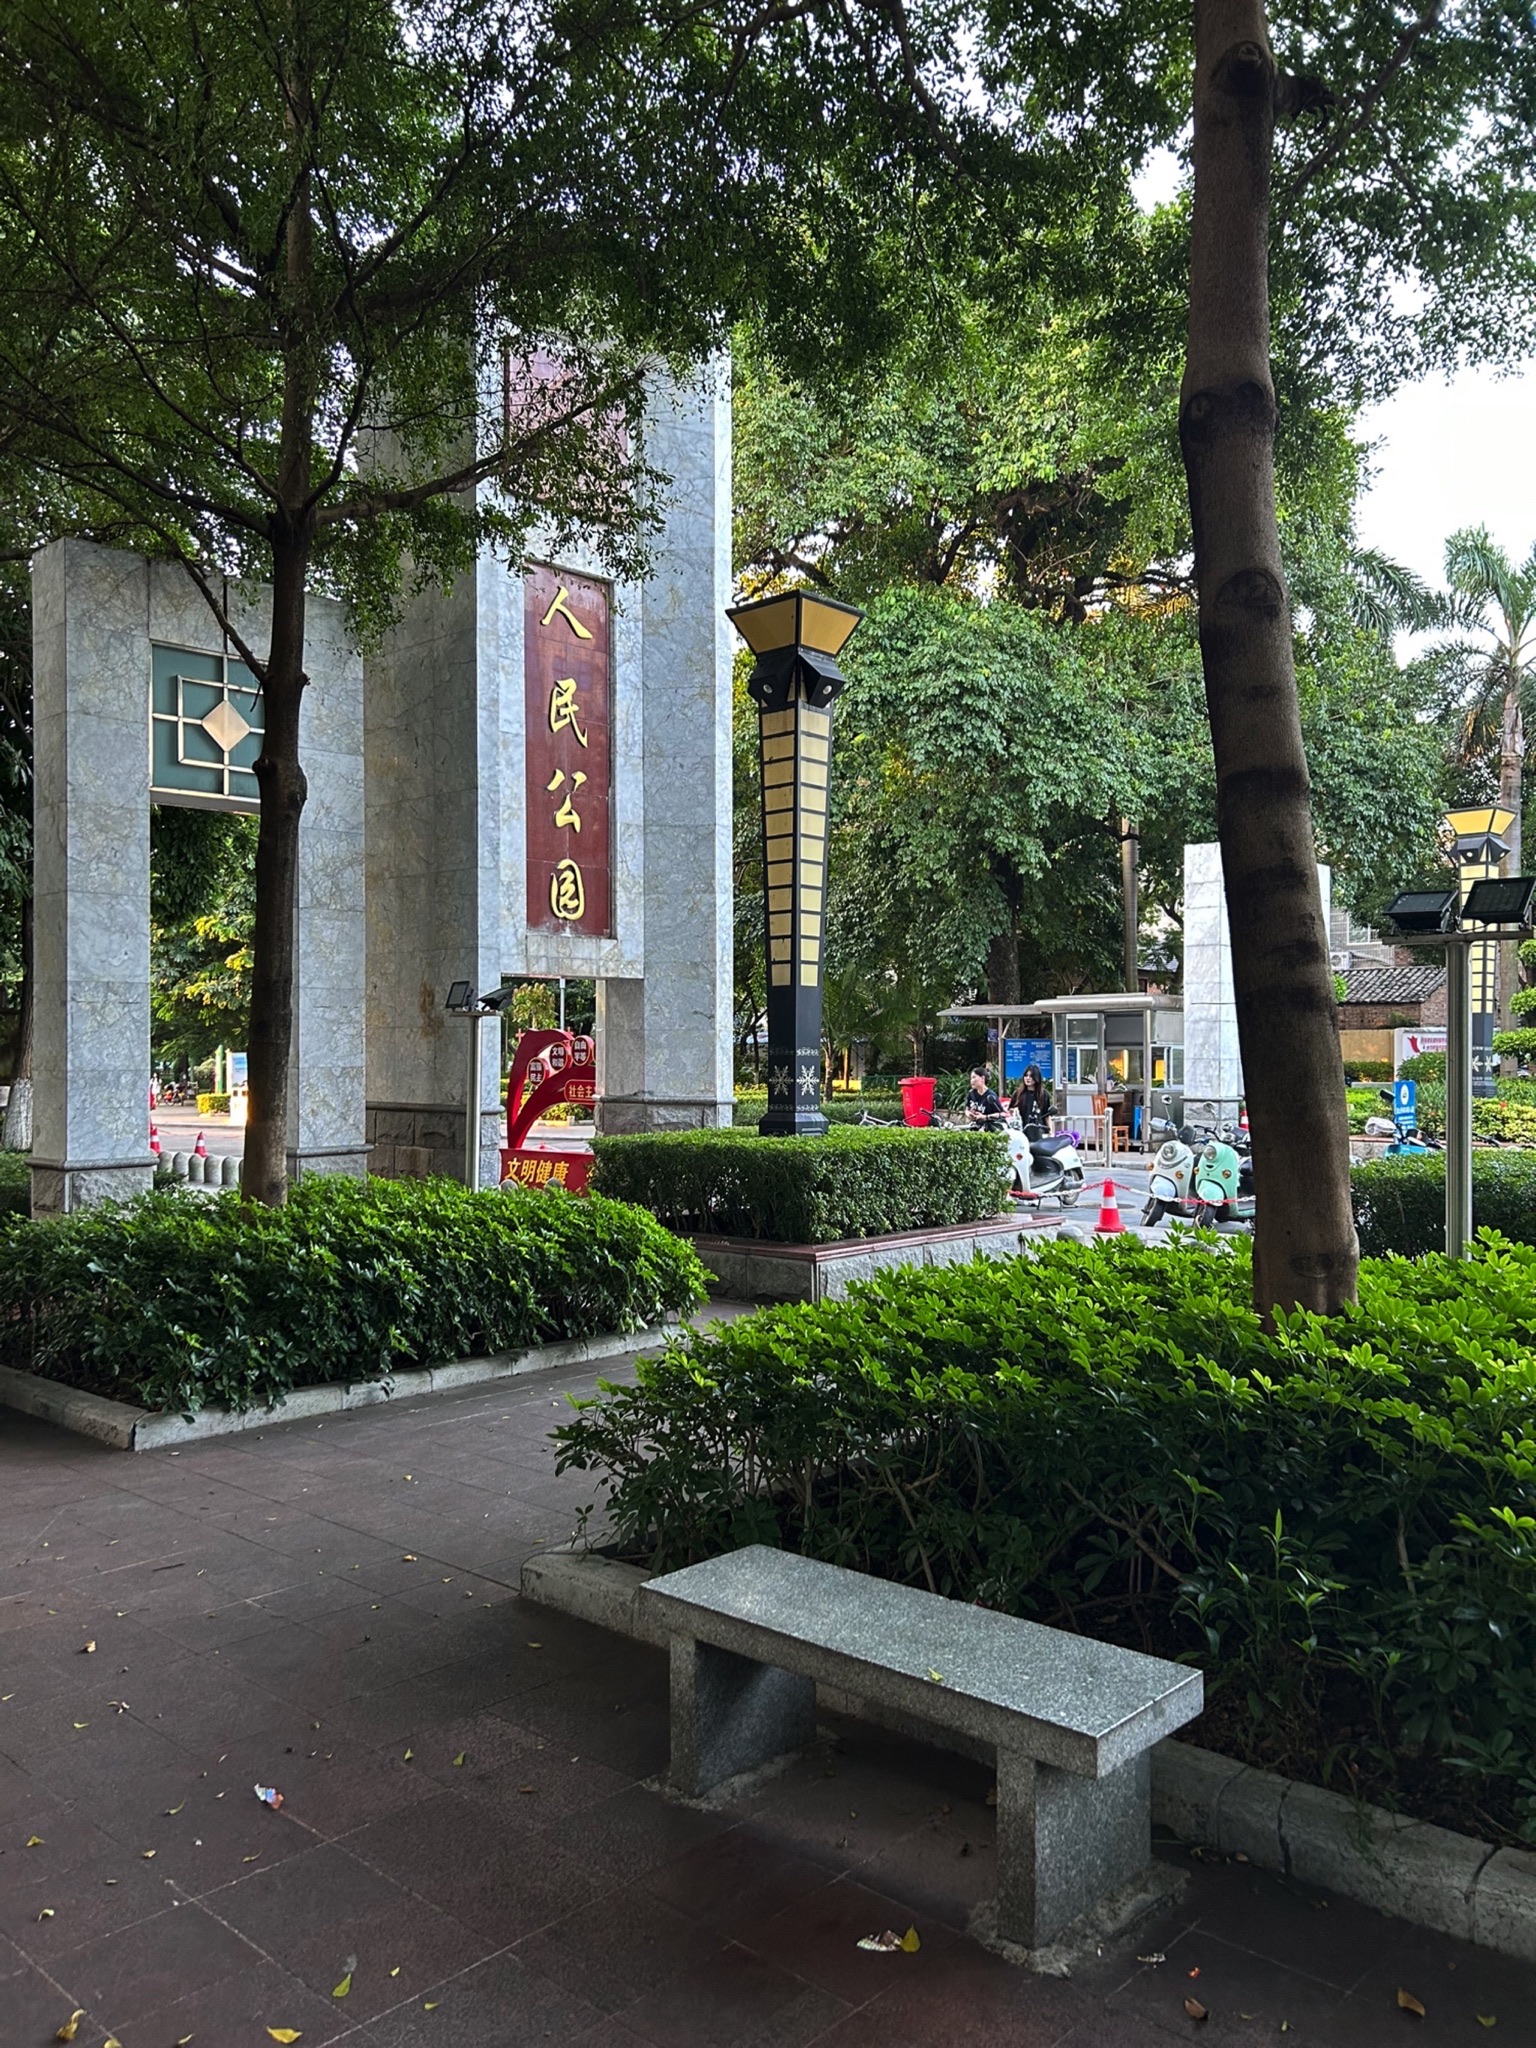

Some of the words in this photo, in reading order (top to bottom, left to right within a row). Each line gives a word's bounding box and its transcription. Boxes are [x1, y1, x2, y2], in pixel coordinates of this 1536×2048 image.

[541, 585, 593, 921] 人民公园
[568, 1084, 596, 1098] 社会主
[504, 1157, 570, 1186] 文明健康
